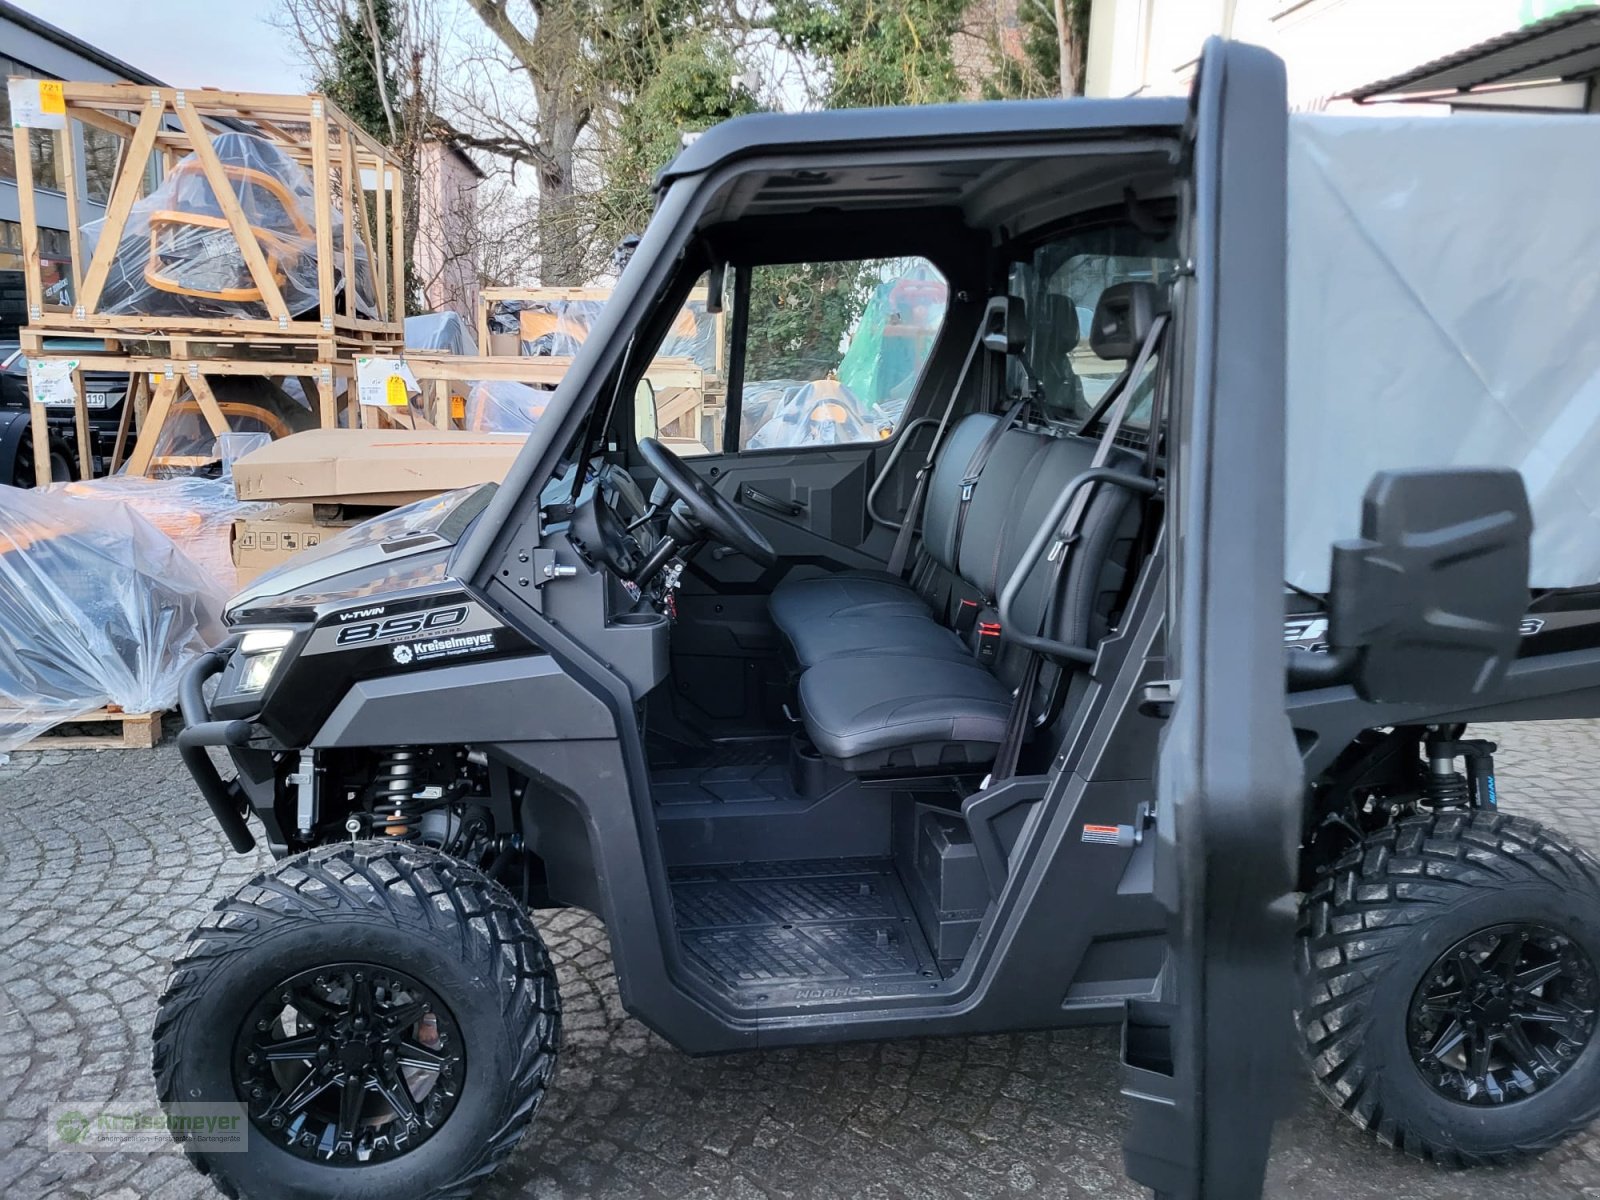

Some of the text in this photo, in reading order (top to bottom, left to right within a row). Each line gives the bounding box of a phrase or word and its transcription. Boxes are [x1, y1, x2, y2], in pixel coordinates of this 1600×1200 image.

[339, 606, 385, 622] V-TWIN
[335, 605, 470, 647] 850
[413, 633, 493, 654] Kreiselmeyer
